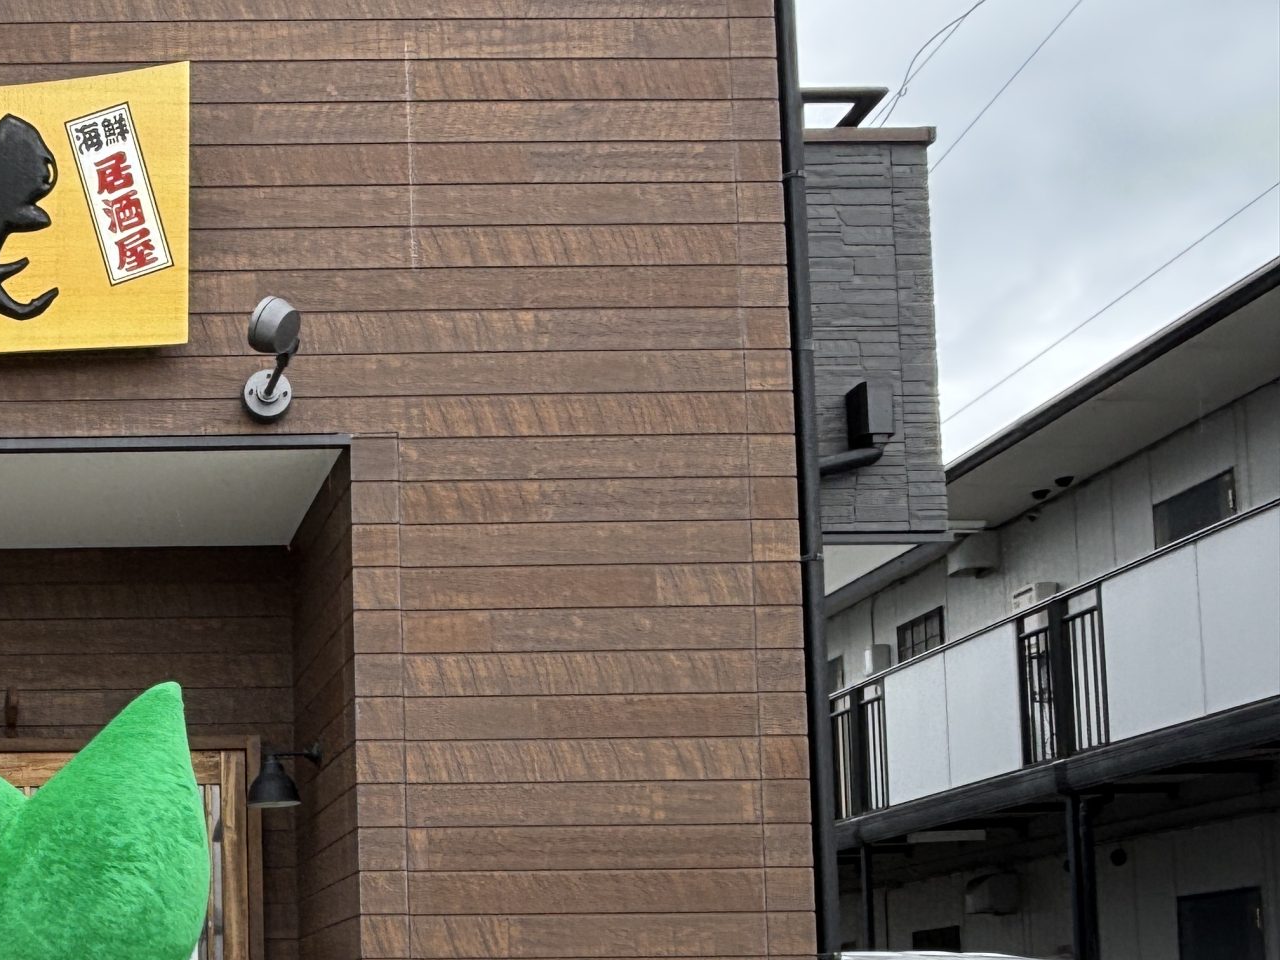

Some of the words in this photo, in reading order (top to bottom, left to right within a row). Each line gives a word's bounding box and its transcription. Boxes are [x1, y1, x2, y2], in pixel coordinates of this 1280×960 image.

[74, 113, 130, 156] 海鮮
[93, 150, 160, 273] 居酒屋
